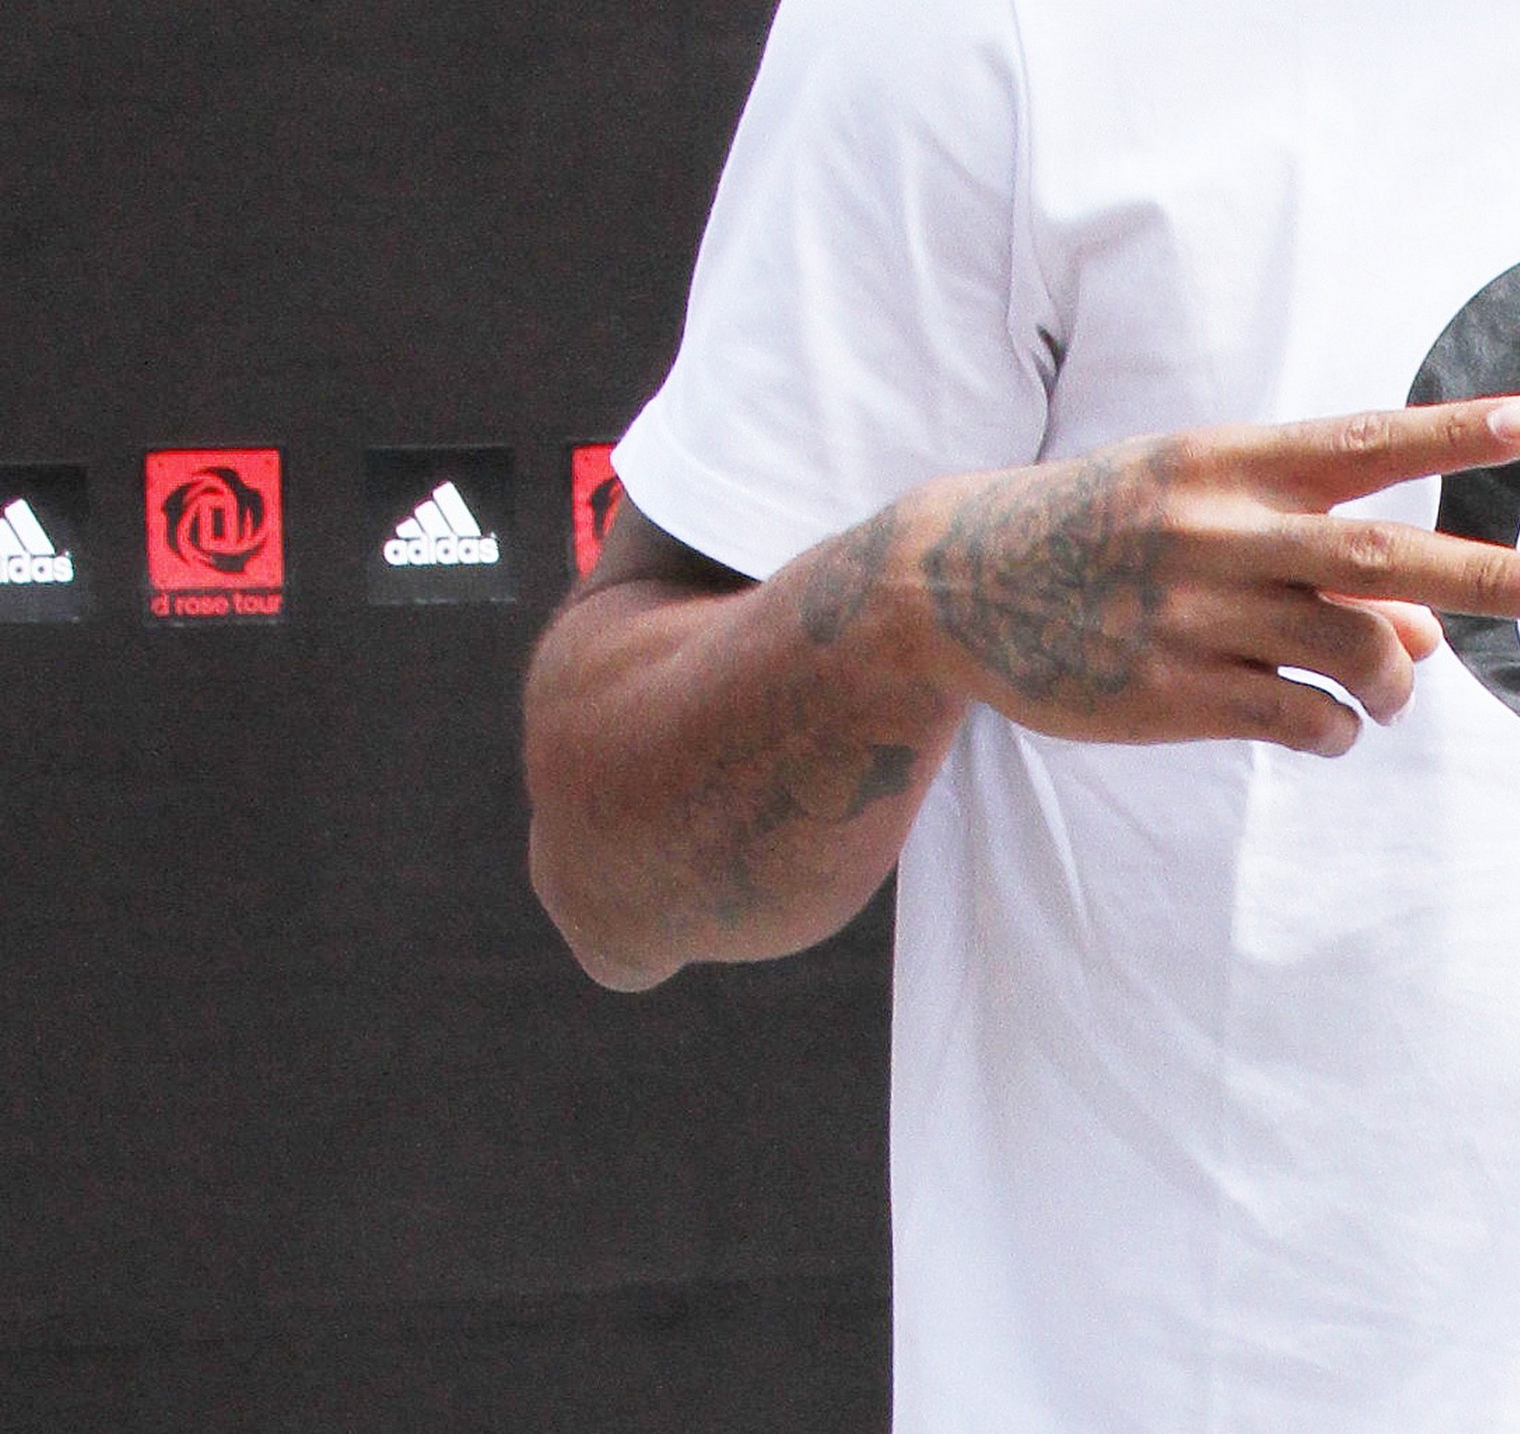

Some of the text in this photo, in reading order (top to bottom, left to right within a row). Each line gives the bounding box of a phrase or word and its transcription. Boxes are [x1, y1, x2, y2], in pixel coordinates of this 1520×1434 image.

[384, 533, 500, 566] adidas
[150, 591, 282, 616] d rose tour
